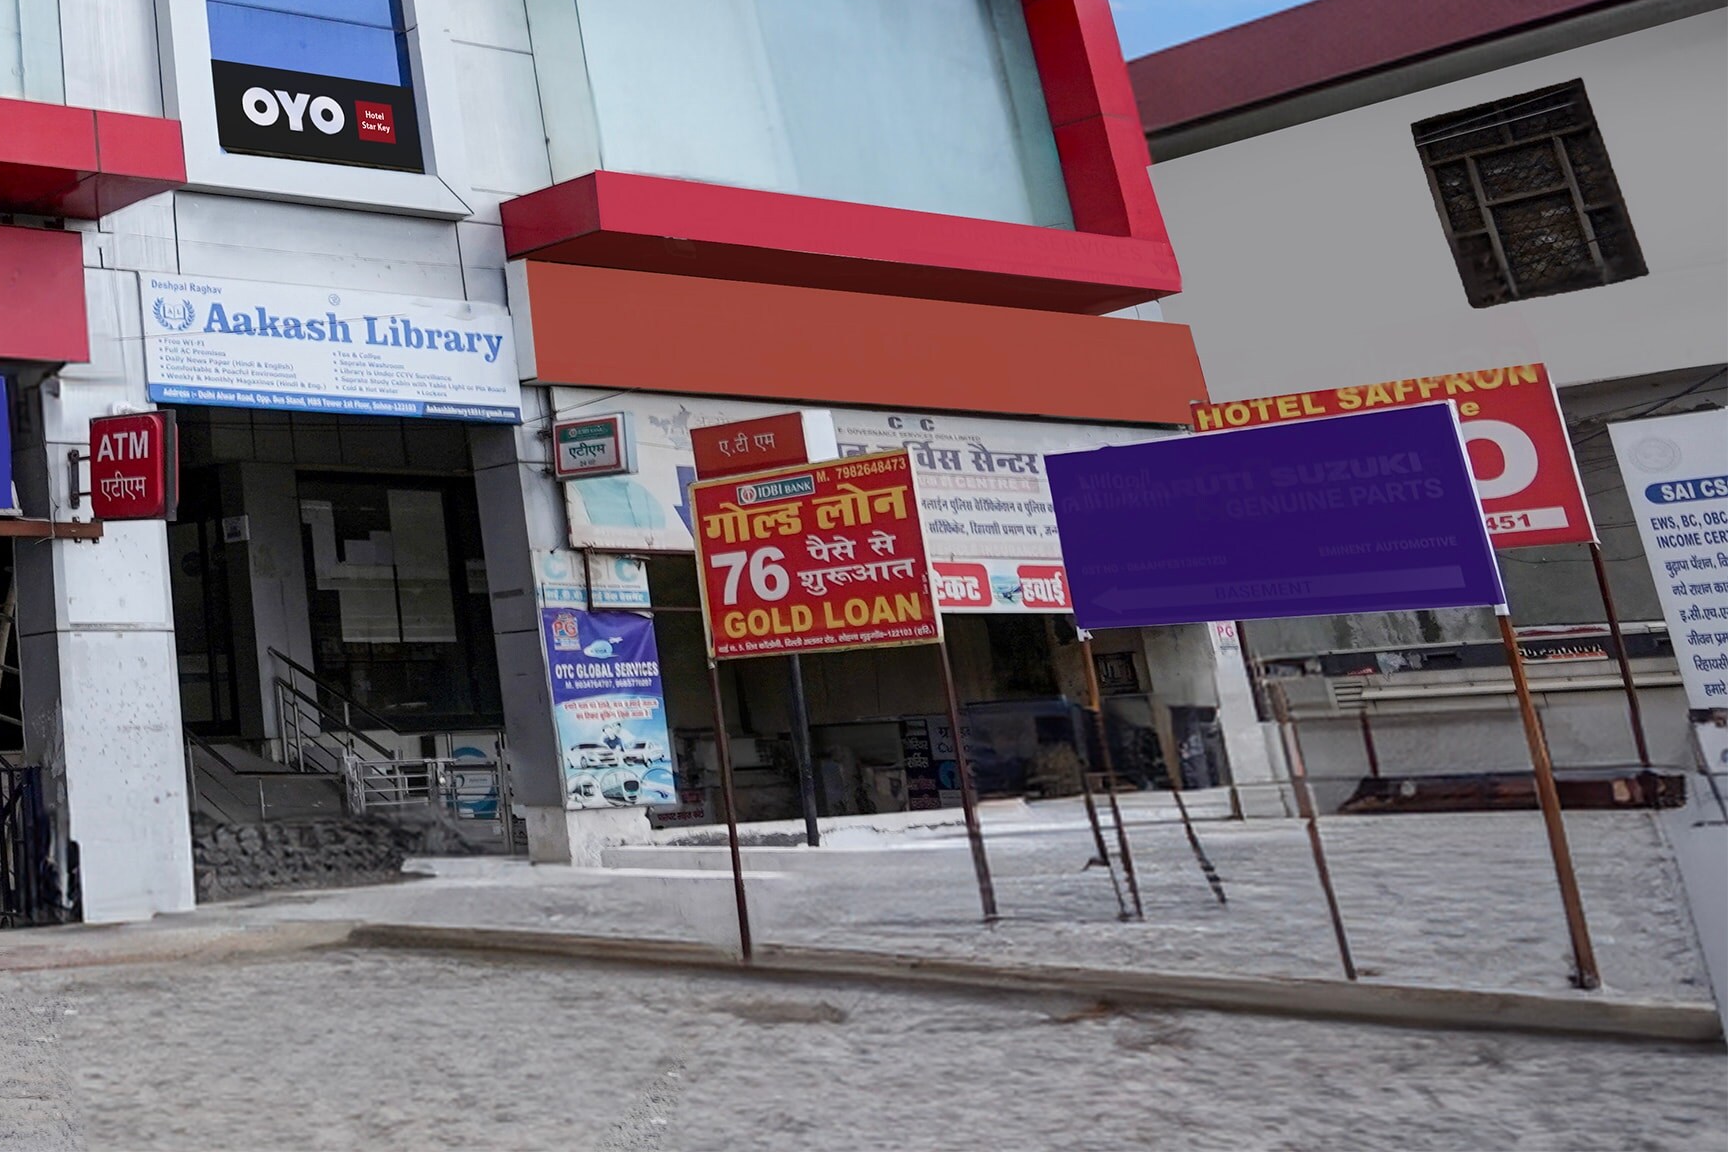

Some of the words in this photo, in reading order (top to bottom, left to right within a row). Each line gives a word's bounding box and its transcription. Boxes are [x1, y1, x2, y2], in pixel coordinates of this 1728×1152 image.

[242, 87, 345, 134] OYO
[365, 110, 385, 120] Hotel
[362, 121, 376, 130] Star
[377, 123, 390, 134] Key
[190, 281, 222, 295] Raghav
[203, 302, 352, 343] Aakash
[363, 315, 503, 363] Library
[1196, 391, 1326, 432] HOTEL
[1336, 364, 1538, 410] SAFFRON
[846, 428, 898, 437] GOVERNANCE
[97, 430, 149, 463] ATM
[568, 442, 606, 459] एटीएम
[967, 442, 1040, 475] सैन्टर
[816, 470, 830, 483] M.
[835, 457, 907, 480] 7982648473
[100, 470, 147, 502] एटीएम
[758, 484, 782, 499] IDBI
[785, 481, 812, 494] BANK
[1660, 482, 1697, 502] SAI
[1699, 478, 1728, 498] CS
[703, 501, 803, 544] गोल्ड
[811, 482, 908, 530] लोन
[1650, 516, 1680, 531] EWS,
[1681, 514, 1702, 528] BC,
[1656, 532, 1703, 549] INCOME
[710, 545, 790, 606] 76
[805, 534, 857, 563] पैसे
[868, 529, 897, 556] से
[797, 558, 916, 597] शुरूआत
[1020, 571, 1066, 606] हवाई
[1672, 581, 1688, 597] नये
[1689, 583, 1714, 596] राशन
[724, 604, 814, 639] GOLD
[823, 591, 923, 630] LOAN
[1686, 631, 1714, 647] जीवन
[555, 663, 575, 679] OTC
[576, 663, 614, 679] GLOBAL
[614, 661, 659, 677] SERVICES
[1704, 679, 1728, 697] हमारे
